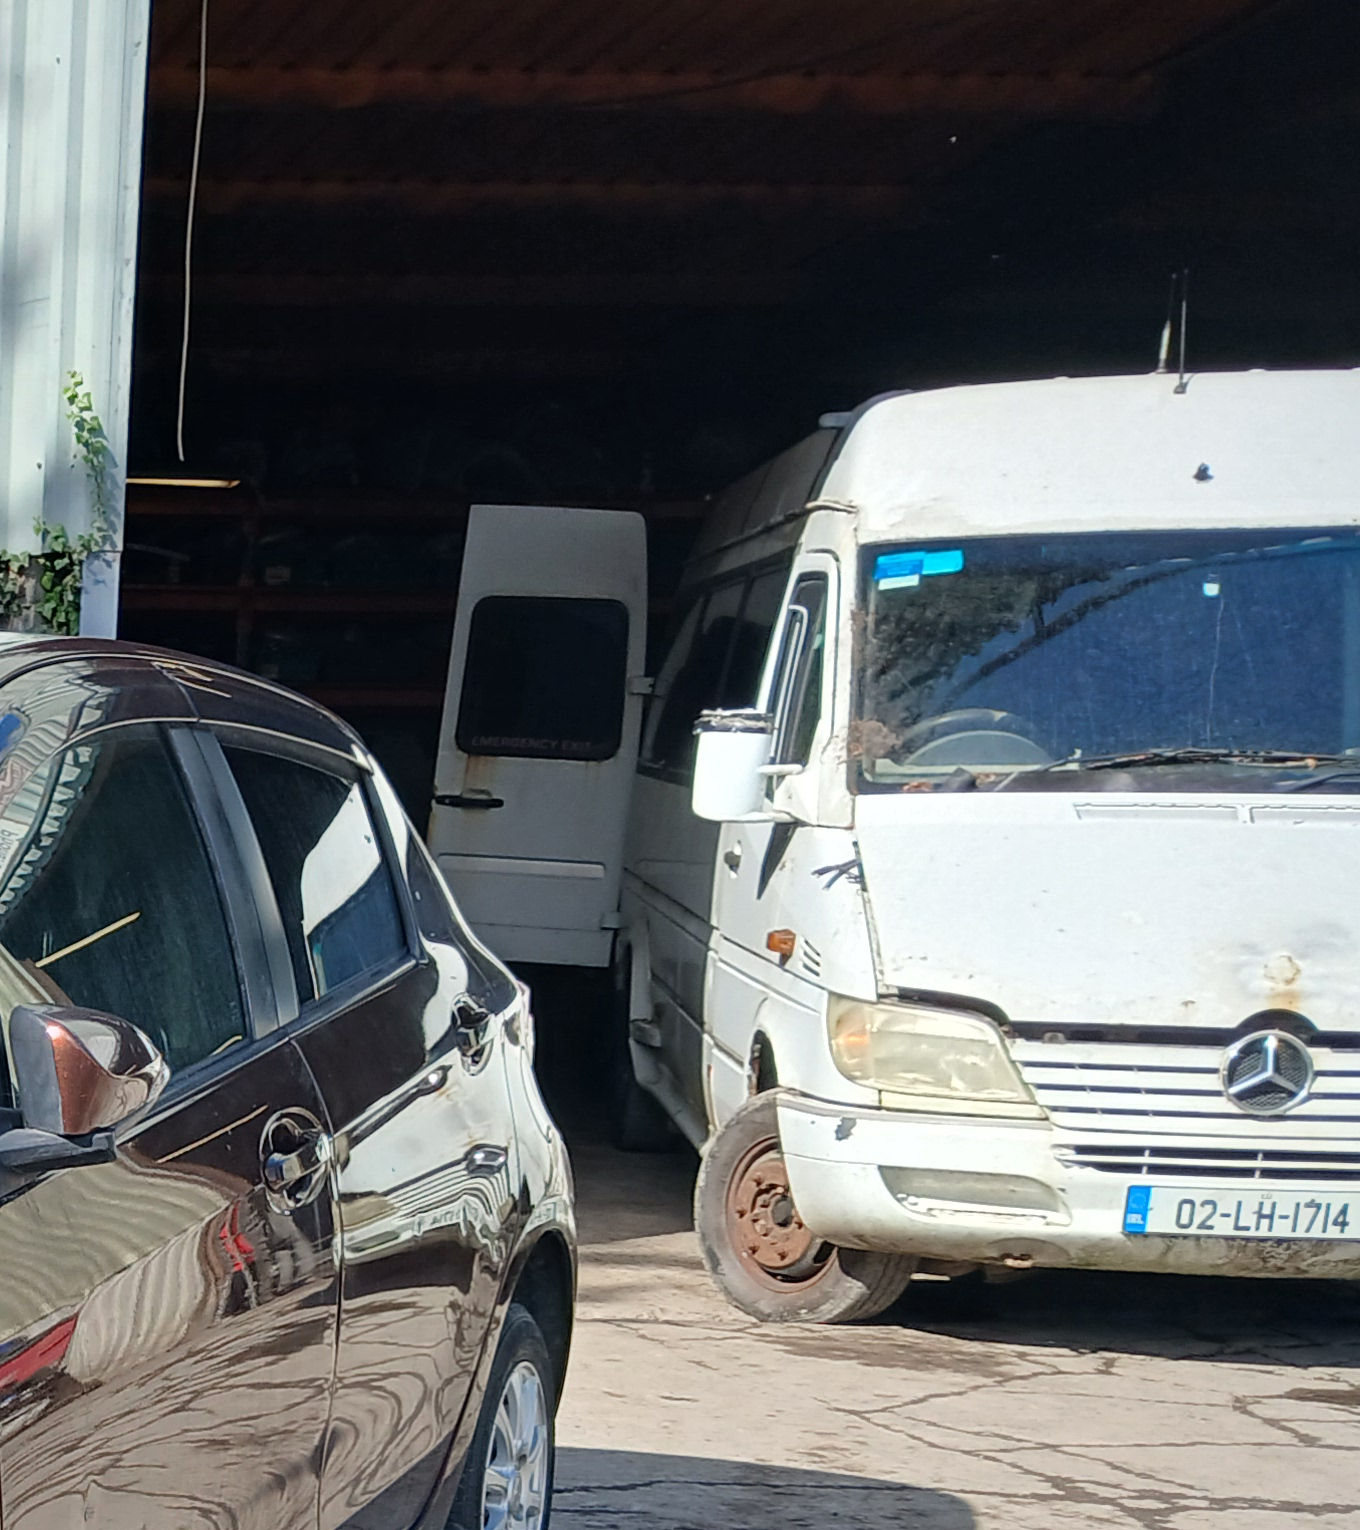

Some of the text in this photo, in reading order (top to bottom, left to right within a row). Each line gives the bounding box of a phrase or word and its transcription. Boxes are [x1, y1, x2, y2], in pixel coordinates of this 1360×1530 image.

[471, 736, 591, 752] EMERGENCY EXIT
[1175, 1198, 1350, 1234] 02-LH-1714
